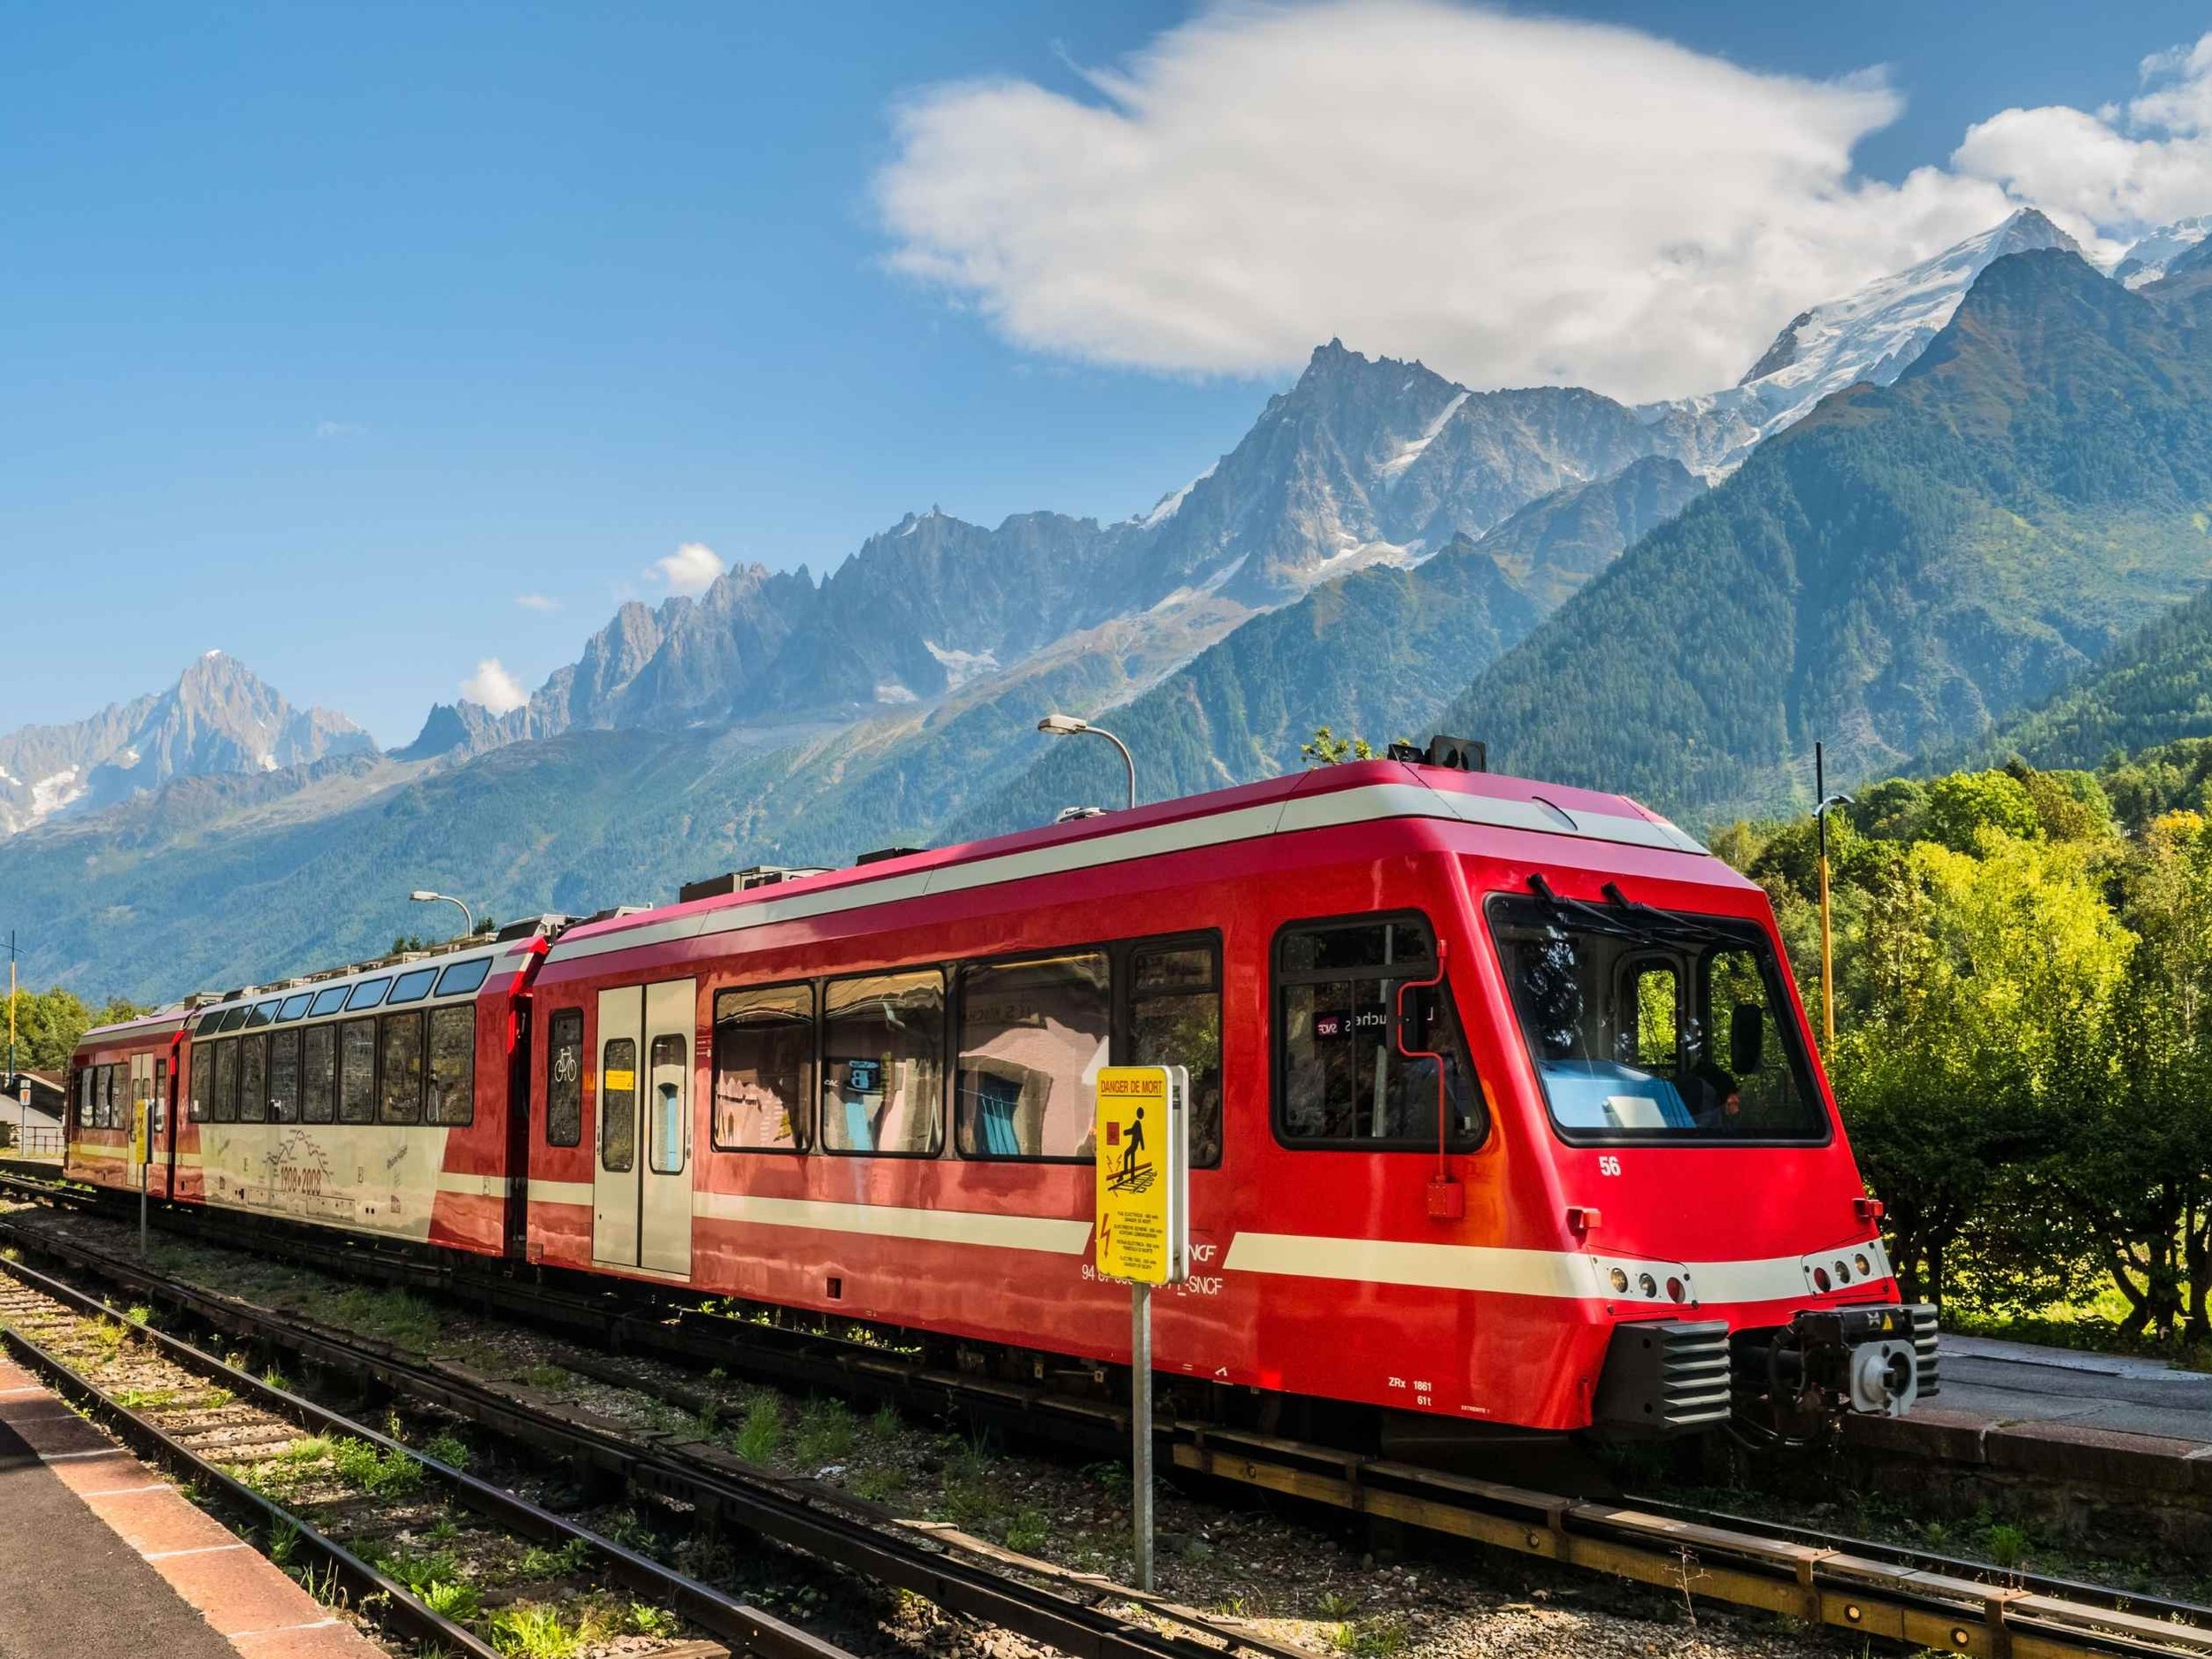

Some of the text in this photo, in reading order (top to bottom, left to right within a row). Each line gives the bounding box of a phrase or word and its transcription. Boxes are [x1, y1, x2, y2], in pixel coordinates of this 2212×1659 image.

[1101, 1079, 1163, 1094] DANGER DE MORT
[1599, 1156, 1622, 1177] 56
[1188, 1244, 1217, 1262] NCF
[1081, 1263, 1095, 1281] 94
[1413, 1380, 1432, 1392] 1861
